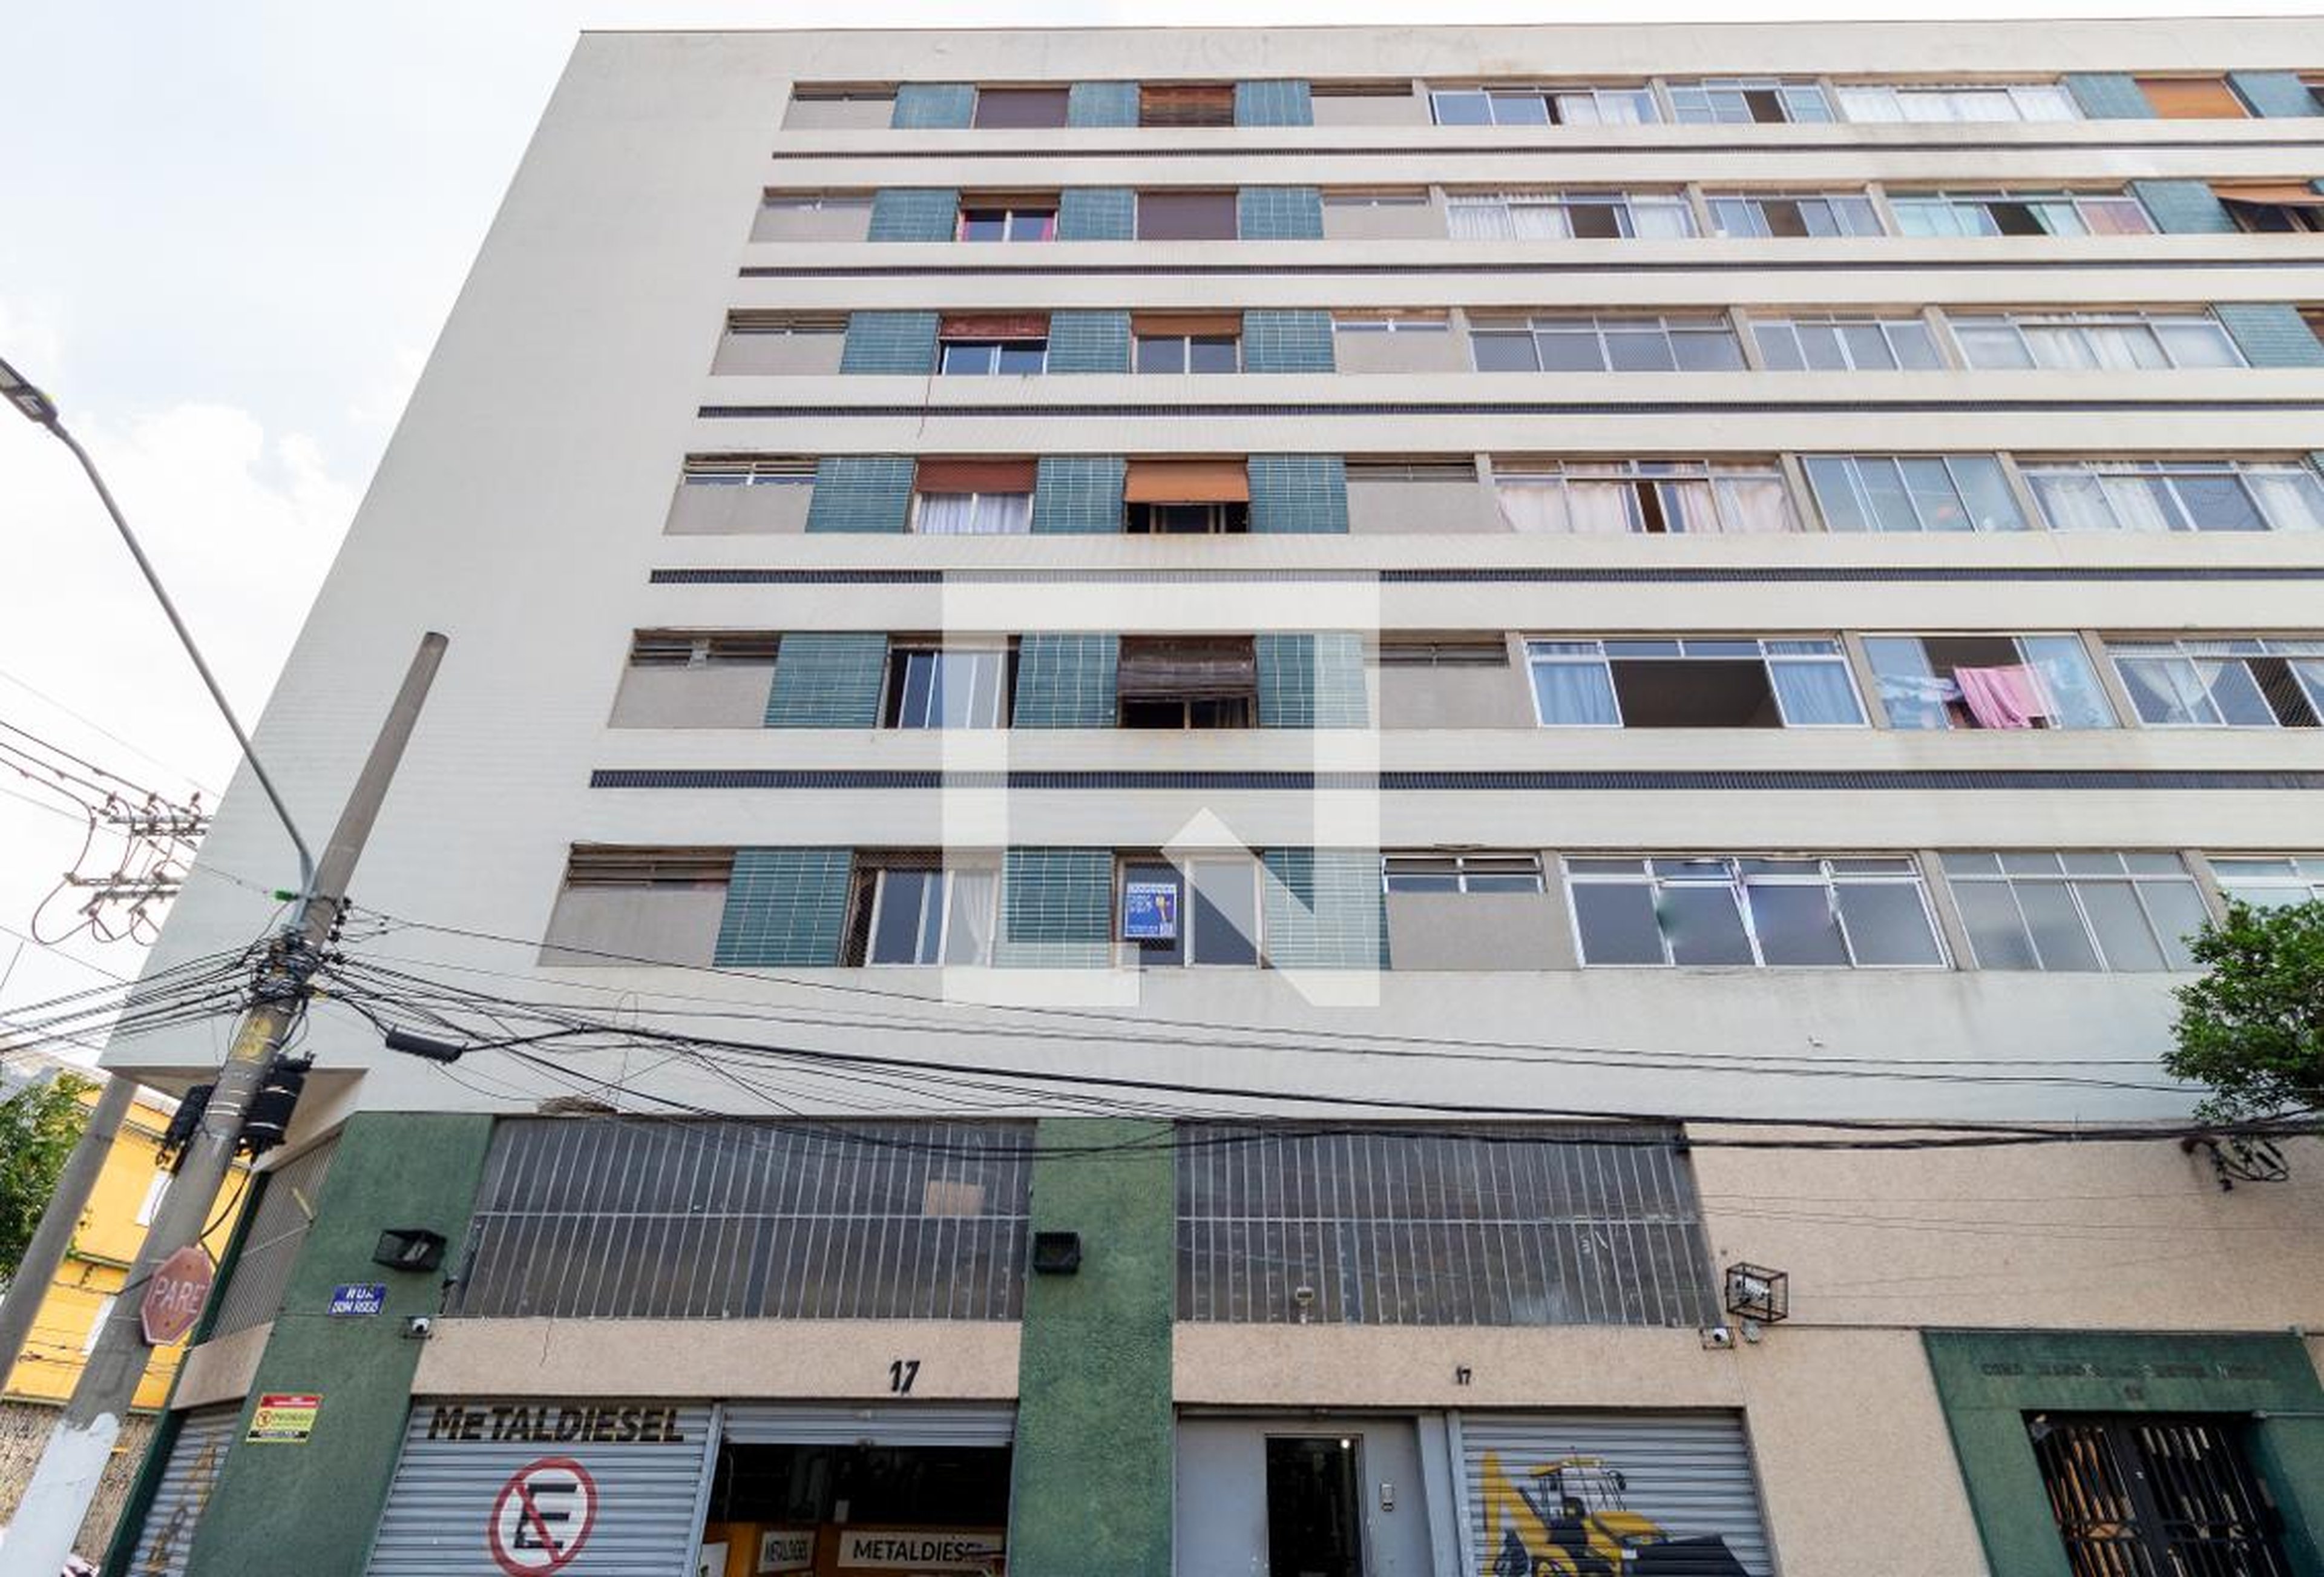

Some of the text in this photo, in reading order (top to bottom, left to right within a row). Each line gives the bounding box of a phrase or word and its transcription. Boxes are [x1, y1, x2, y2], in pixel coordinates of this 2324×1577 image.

[151, 1276, 206, 1313] PARE
[890, 1360, 921, 1393] 17
[1456, 1366, 1471, 1385] 17
[853, 1539, 986, 1563] METALDIES
